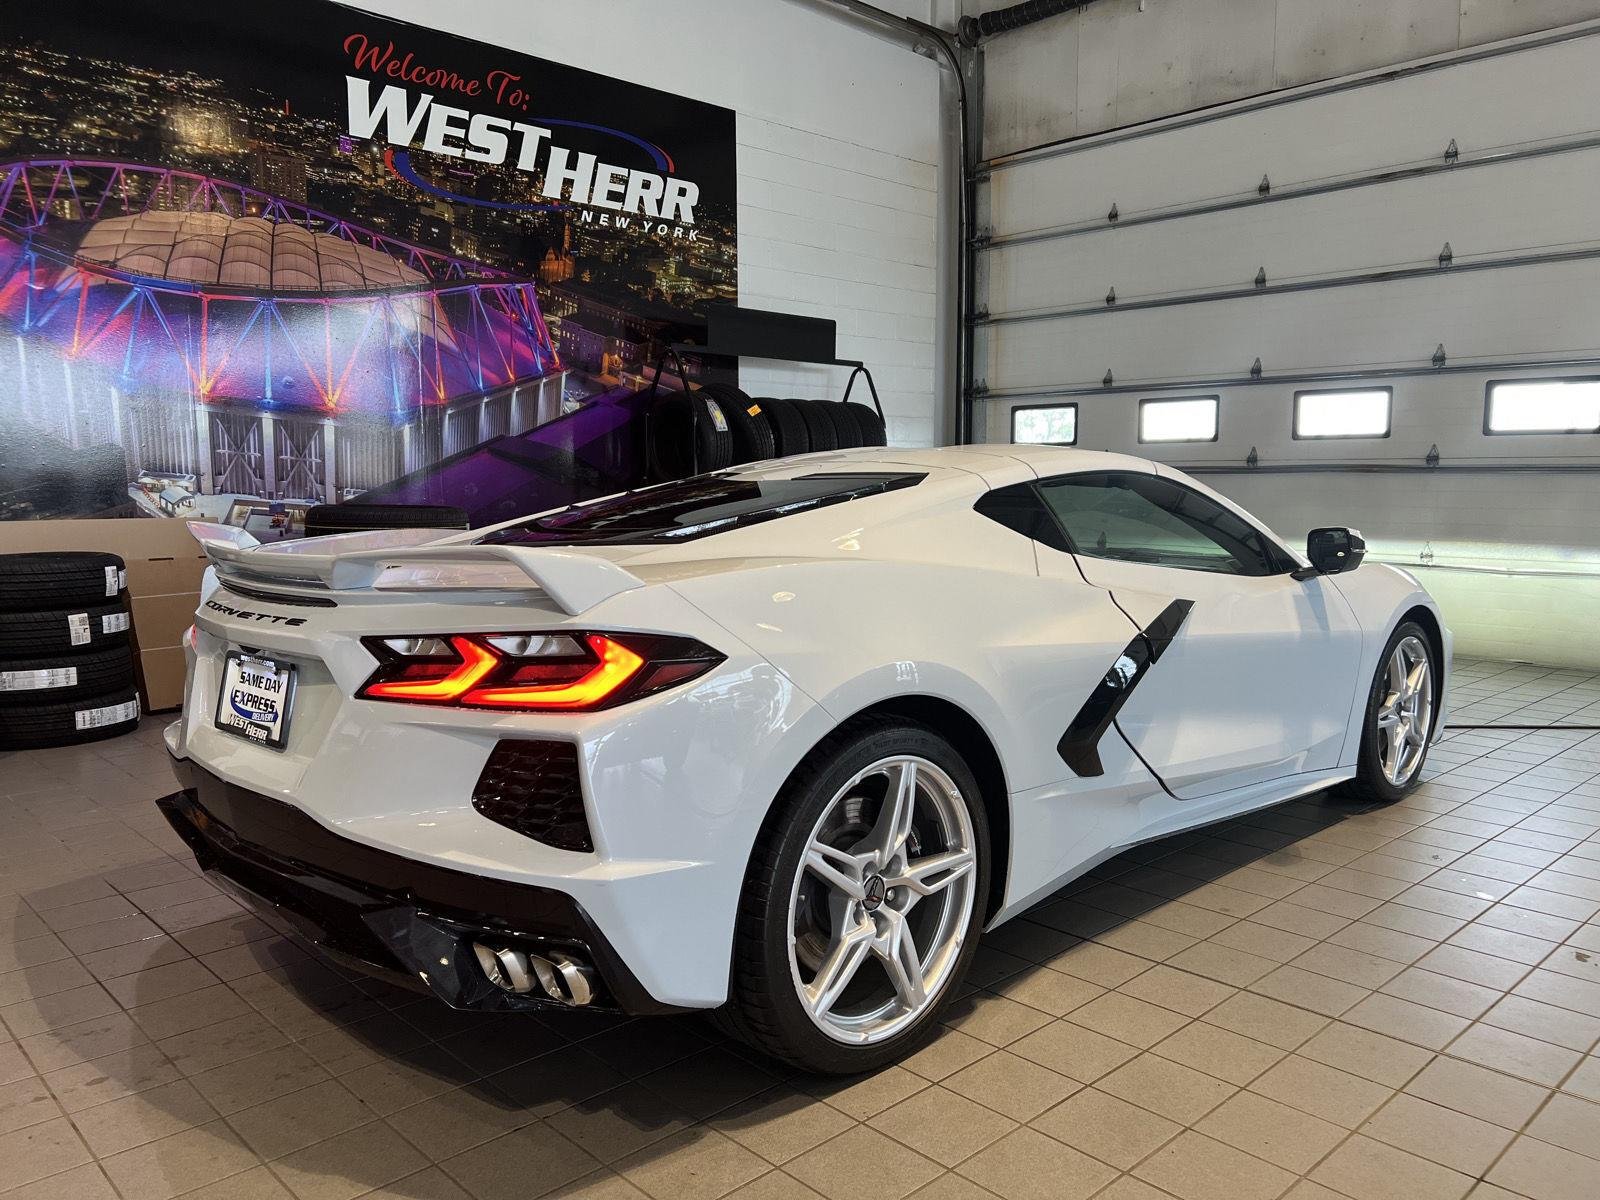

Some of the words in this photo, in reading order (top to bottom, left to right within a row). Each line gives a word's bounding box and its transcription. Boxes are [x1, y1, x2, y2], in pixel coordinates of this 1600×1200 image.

[343, 33, 482, 97] Welcome
[487, 69, 531, 111] To:
[345, 75, 551, 172] WEST
[541, 145, 700, 224] HERR
[581, 210, 630, 229] NEW
[643, 220, 699, 241] YORK
[205, 600, 308, 626] CORVETTE
[239, 671, 265, 689] SAME
[264, 677, 283, 694] DAY
[234, 689, 277, 713] EXPRESS
[252, 712, 275, 722] DELIVERY
[245, 724, 268, 741] HERR
